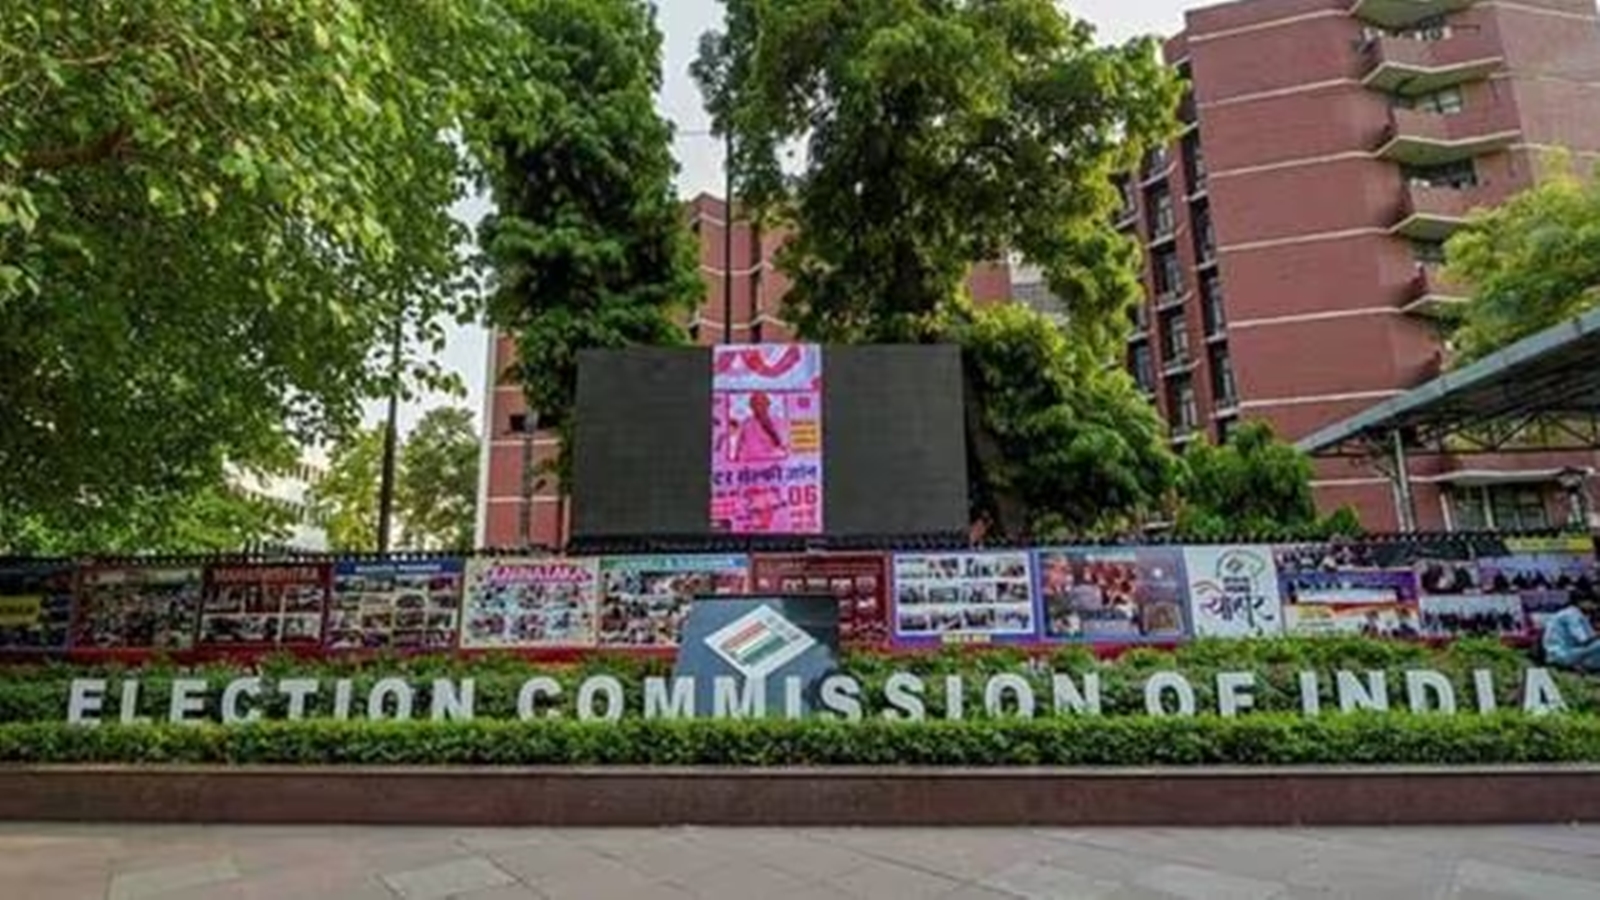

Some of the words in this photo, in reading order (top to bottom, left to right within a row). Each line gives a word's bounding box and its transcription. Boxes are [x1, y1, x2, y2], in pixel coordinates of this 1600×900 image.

[67, 678, 476, 727] ELECTION
[517, 672, 1102, 724] COMMISSION
[1144, 670, 1255, 718] OF
[1300, 667, 1568, 716] INDIA
